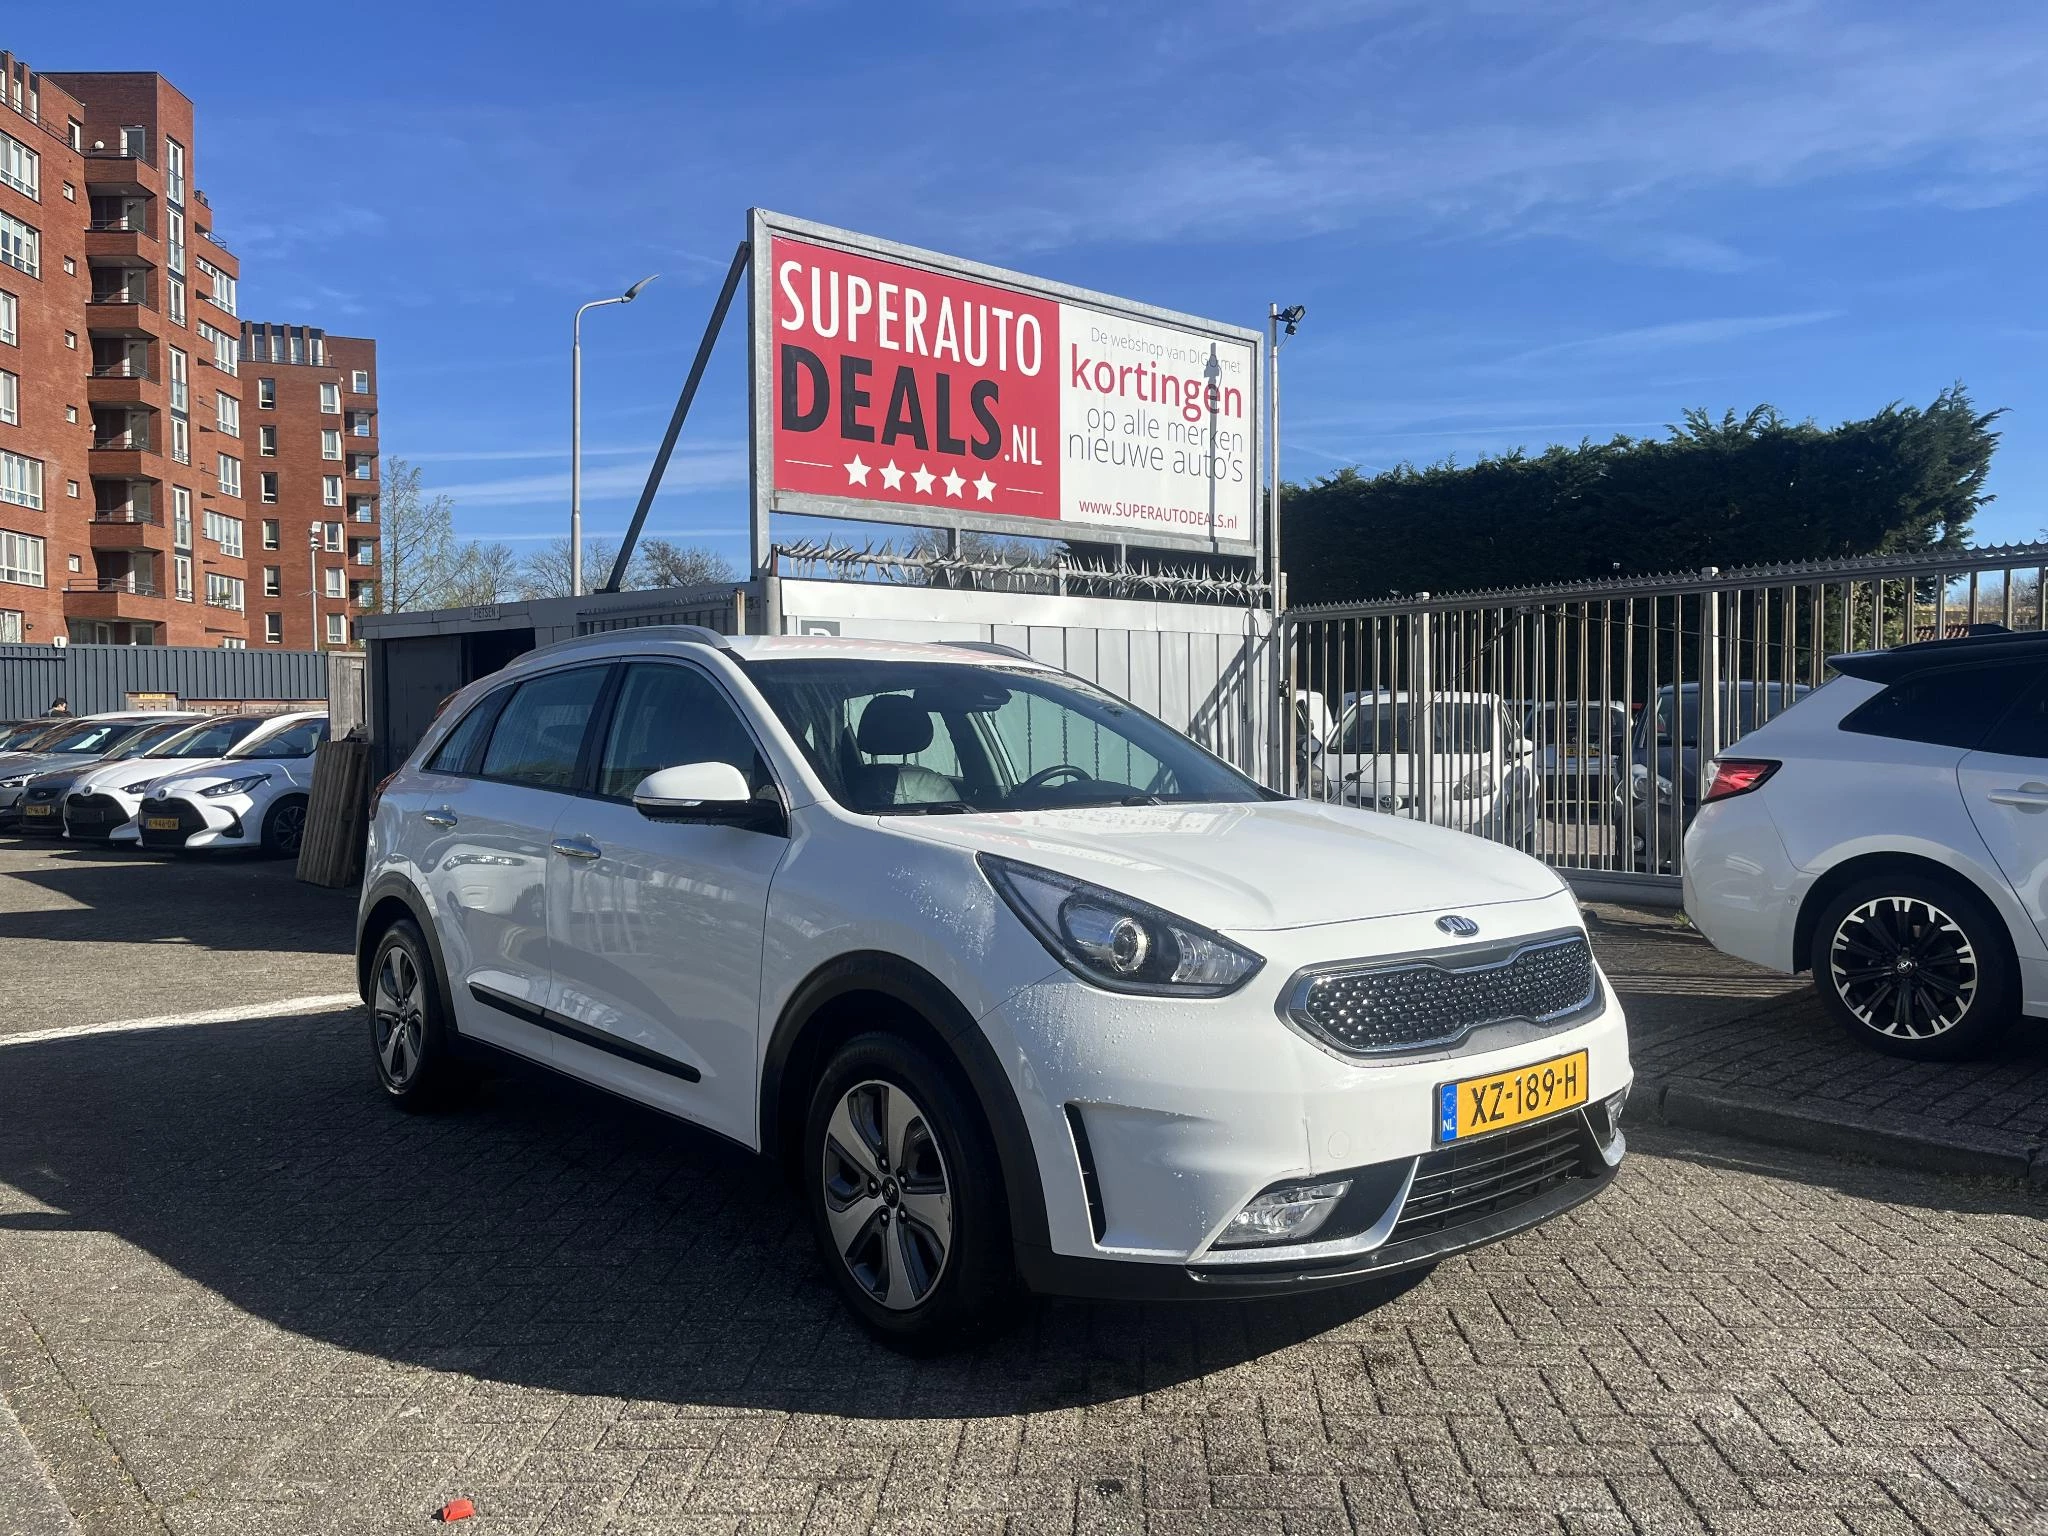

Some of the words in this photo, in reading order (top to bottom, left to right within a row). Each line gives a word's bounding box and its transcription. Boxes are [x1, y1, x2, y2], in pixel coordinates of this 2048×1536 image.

[779, 260, 1042, 377] SUPERAUTO
[1091, 327, 1108, 344] De
[1111, 334, 1164, 359] webshop
[1166, 348, 1186, 362] van
[1222, 359, 1241, 374] met
[1072, 343, 1242, 422] kortingen
[1087, 408, 1116, 438] op
[1124, 409, 1160, 439] alle
[1168, 421, 1243, 453] merken
[1069, 429, 1164, 471] nieuwe
[1173, 450, 1243, 482] auto's
[1079, 500, 1237, 529] www.SUPERAUTODEALS.nl
[473, 607, 496, 619] FIETSEN
[1440, 917, 1476, 931] KIA
[1471, 1061, 1577, 1127] XZ-189-H
[1443, 1119, 1455, 1131] NL
